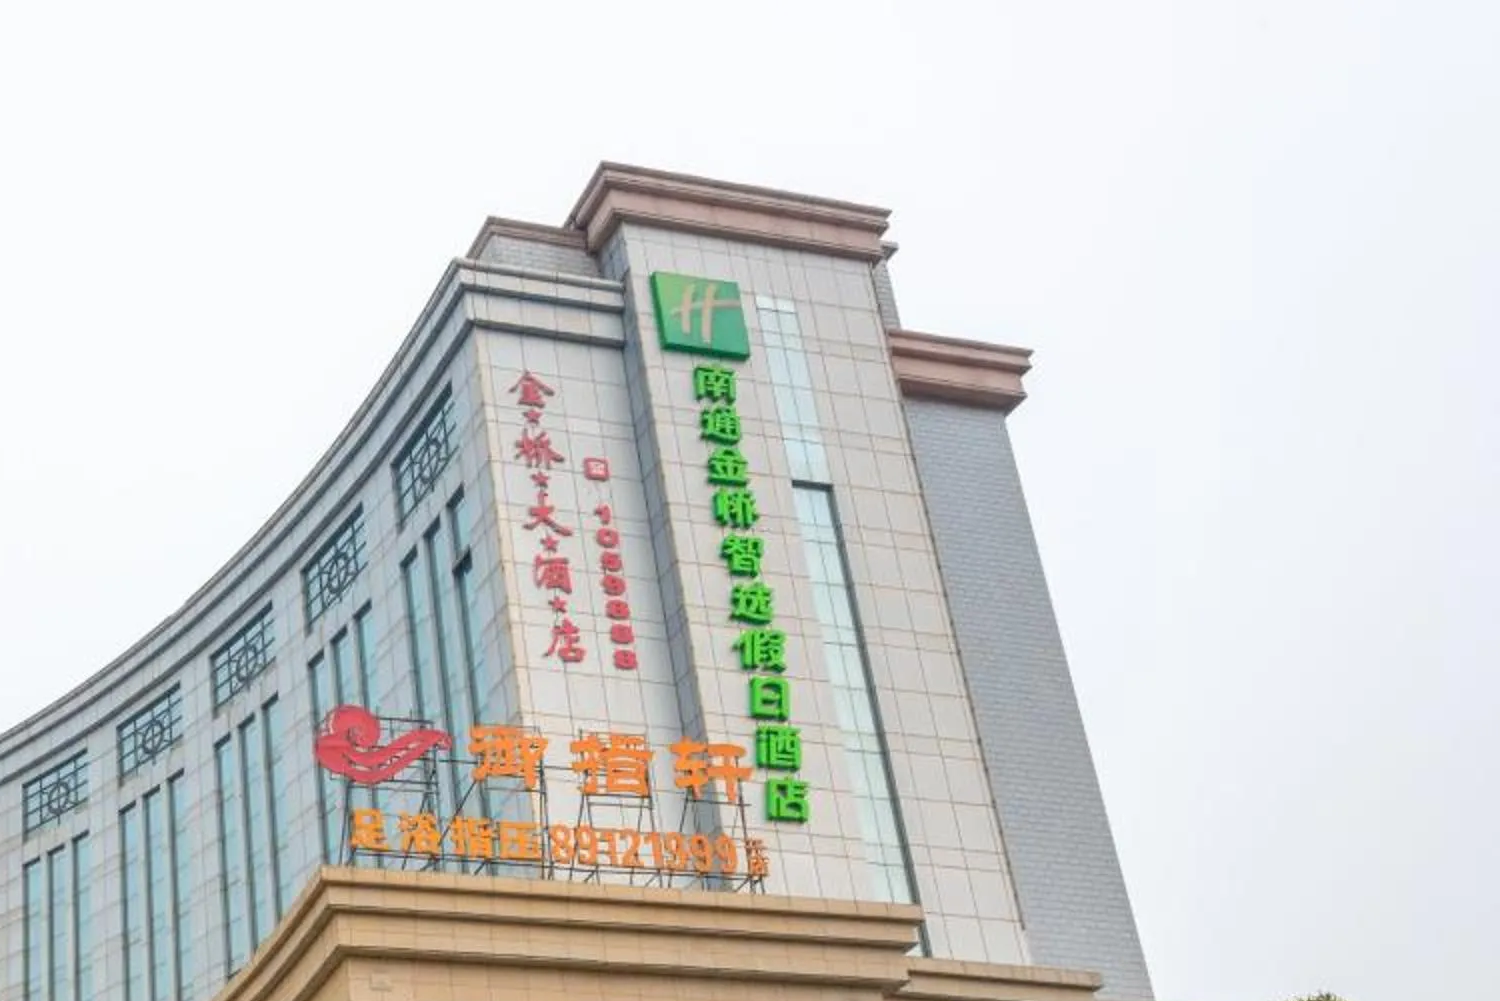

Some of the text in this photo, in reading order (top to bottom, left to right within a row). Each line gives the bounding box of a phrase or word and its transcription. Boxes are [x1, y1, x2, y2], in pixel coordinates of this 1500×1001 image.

[694, 364, 810, 822] 南通金桥智选假日酒店
